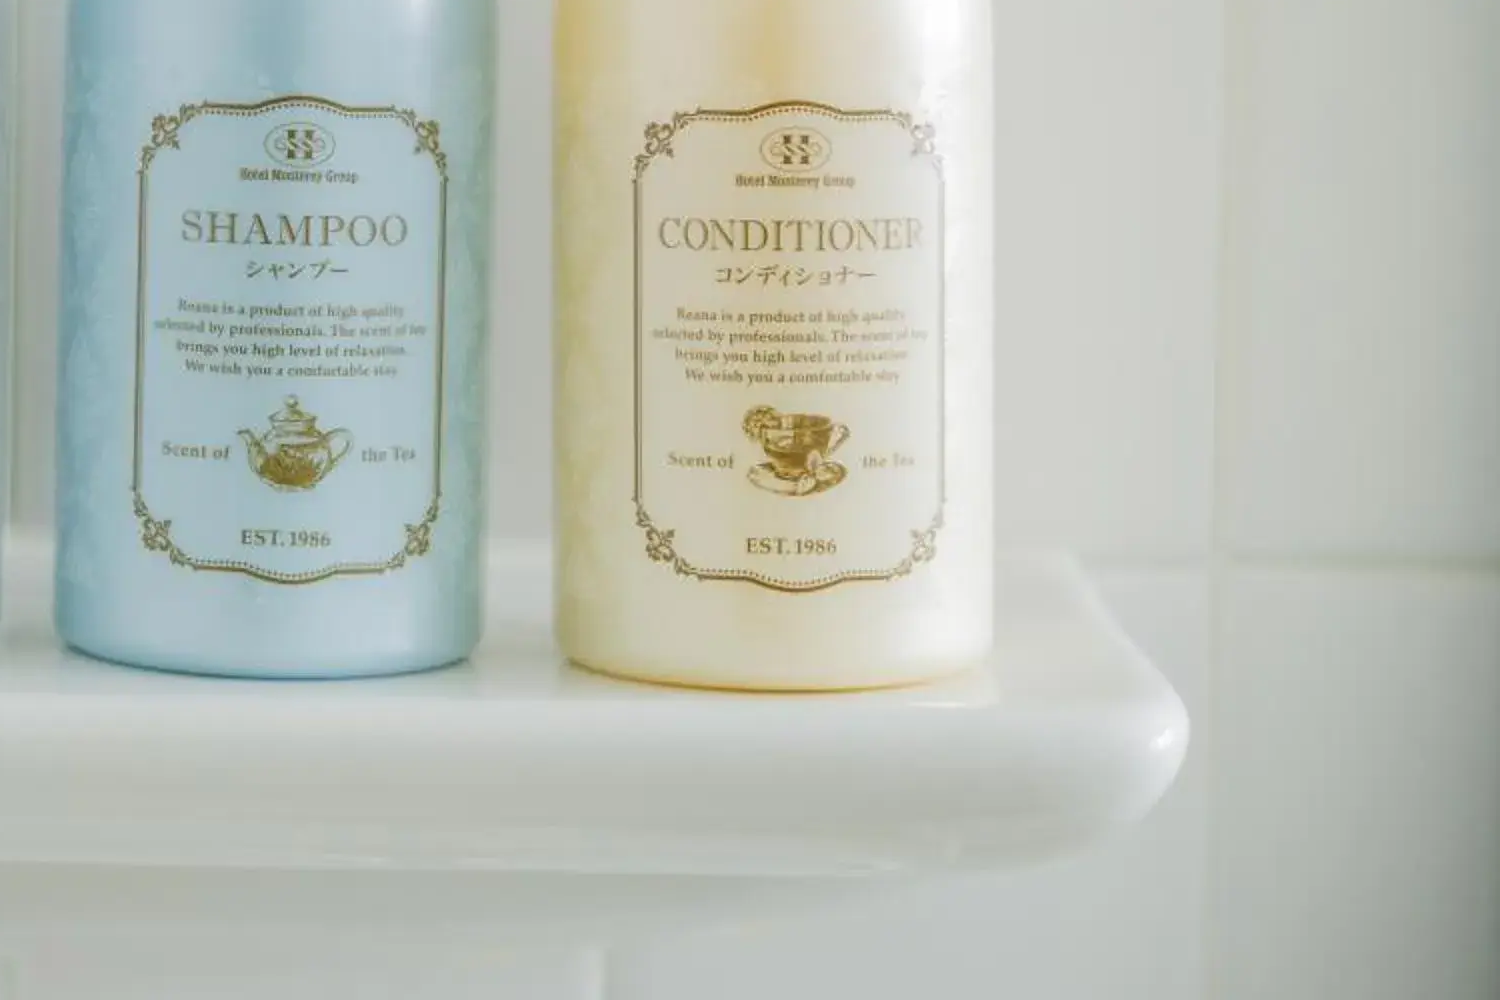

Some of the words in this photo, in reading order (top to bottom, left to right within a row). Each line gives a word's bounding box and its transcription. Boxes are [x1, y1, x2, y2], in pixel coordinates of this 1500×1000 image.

[181, 209, 408, 247] SHAMPOO
[658, 216, 924, 252] CONDITIONER
[246, 257, 349, 281] シャンプー
[714, 264, 877, 287] コンディショナー
[749, 309, 805, 326] product
[209, 320, 225, 338] by
[252, 342, 285, 358] high
[753, 348, 785, 365] high
[247, 365, 272, 380] you
[747, 372, 773, 387] you
[161, 440, 207, 458] Scent
[211, 444, 230, 461] of
[361, 446, 387, 463] the
[667, 452, 712, 469] Scent
[717, 453, 734, 470] of
[240, 528, 285, 547] EST.
[289, 529, 331, 548] 1986
[746, 537, 791, 556] EST.
[794, 538, 837, 556] 1986
